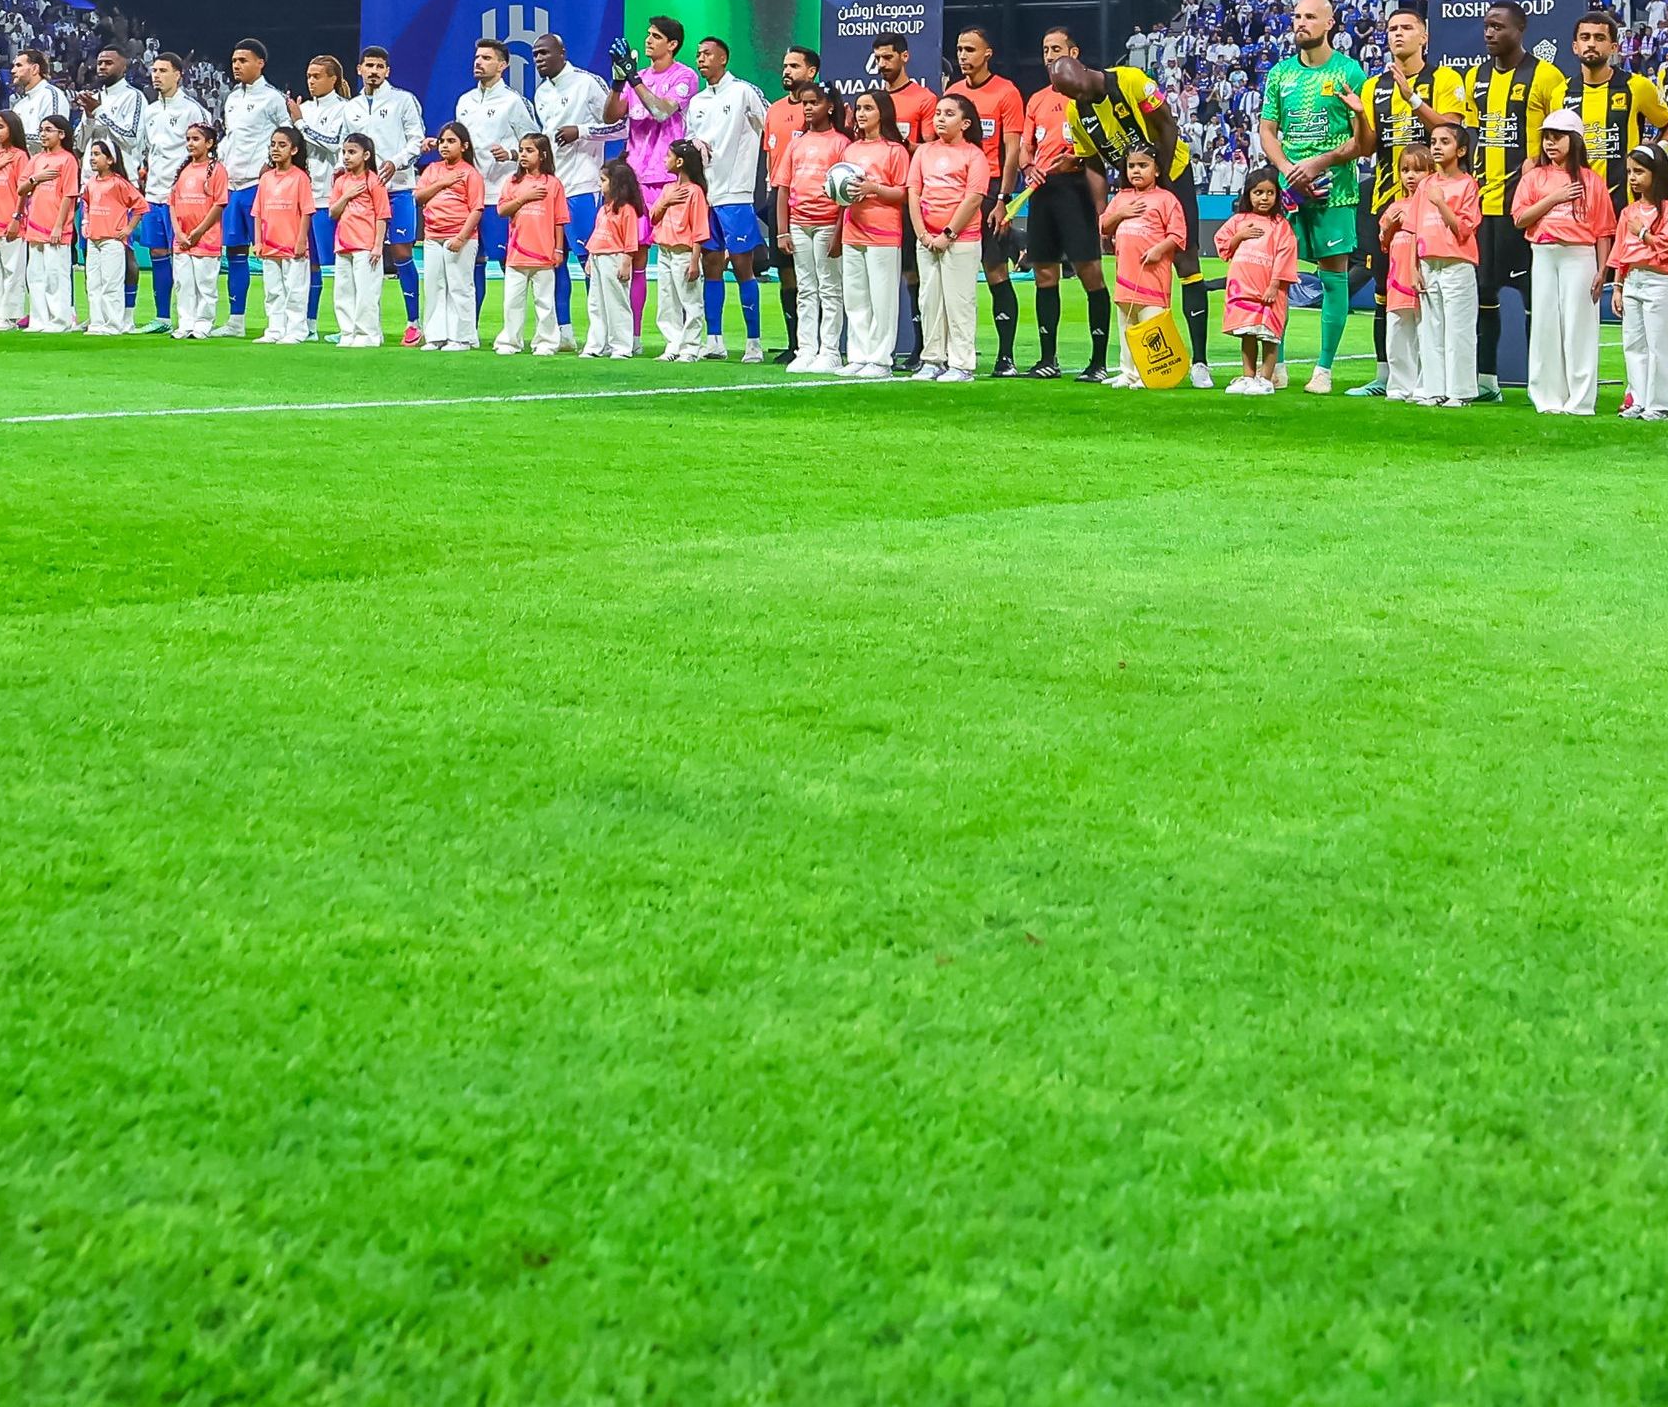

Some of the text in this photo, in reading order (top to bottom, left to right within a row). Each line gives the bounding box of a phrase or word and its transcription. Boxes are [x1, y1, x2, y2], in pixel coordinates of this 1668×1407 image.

[837, 2, 925, 21] مجموعة روشن
[837, 20, 925, 36] ROSHN GROUP
[1584, 122, 1620, 133] شرك
